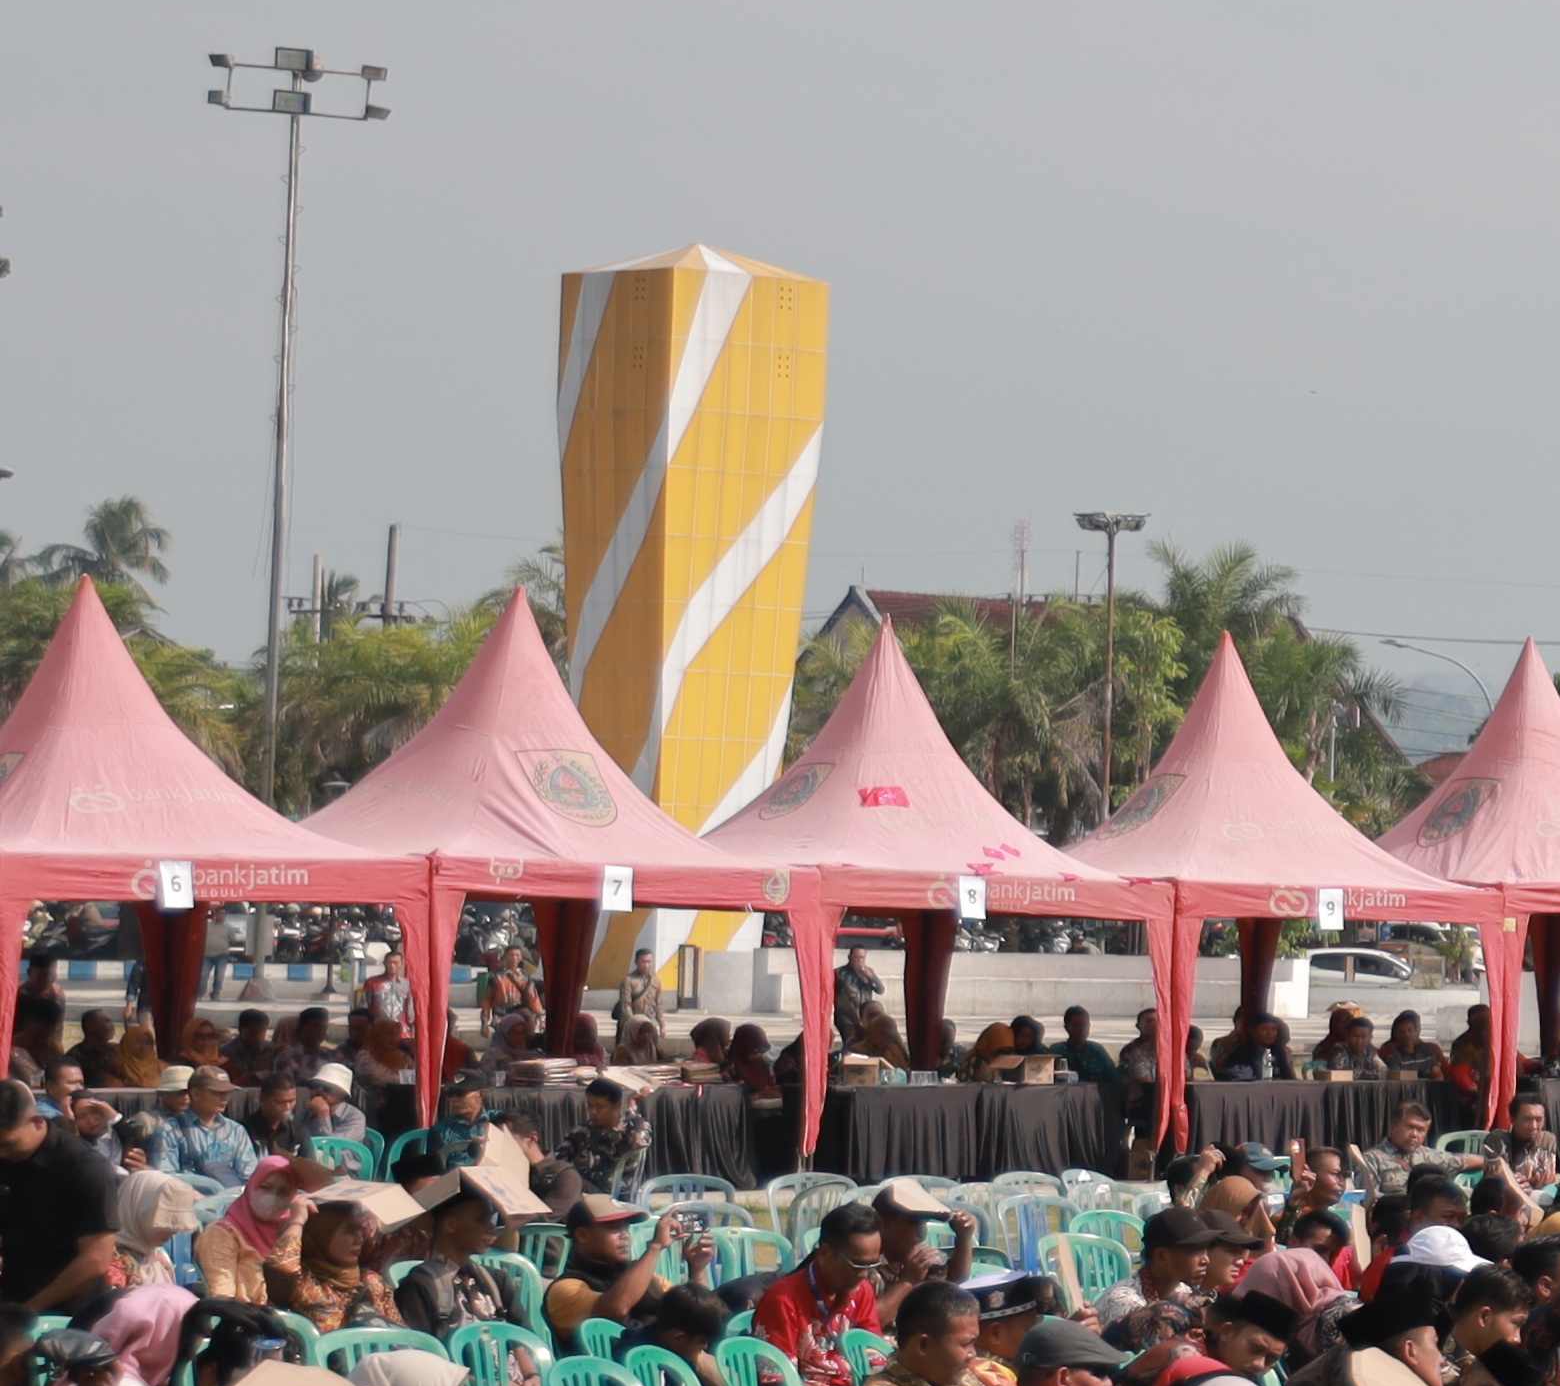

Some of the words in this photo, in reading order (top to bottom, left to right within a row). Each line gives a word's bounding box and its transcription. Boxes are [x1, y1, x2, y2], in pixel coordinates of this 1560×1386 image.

[171, 875, 182, 893] 6
[612, 879, 623, 896] 7
[987, 878, 1076, 905] ankjatim
[968, 889, 977, 904] 8
[1326, 901, 1335, 916] 9
